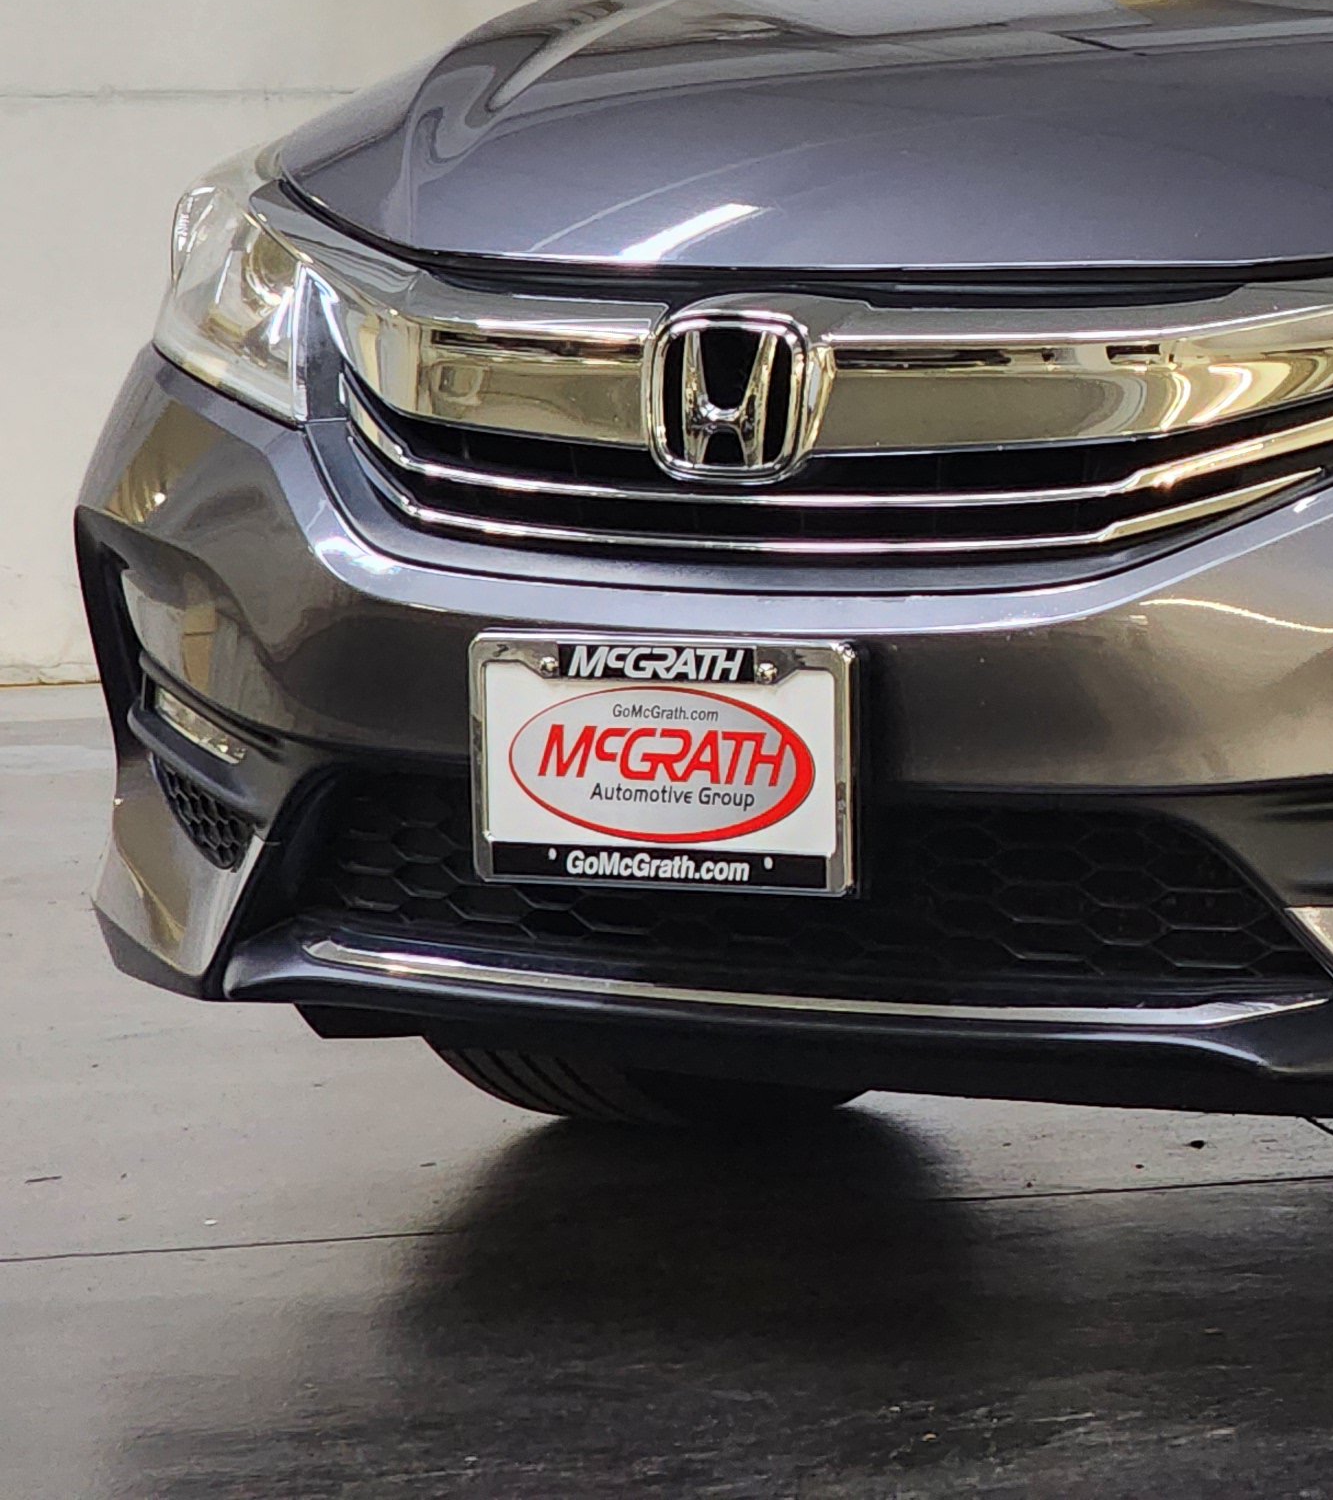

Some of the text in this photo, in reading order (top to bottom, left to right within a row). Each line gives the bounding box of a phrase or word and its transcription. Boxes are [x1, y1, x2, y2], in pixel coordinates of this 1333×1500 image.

[612, 703, 719, 722] GoMcGrath.com
[590, 782, 755, 811] Automotive Group
[566, 850, 751, 882] GoMcGrath.com
